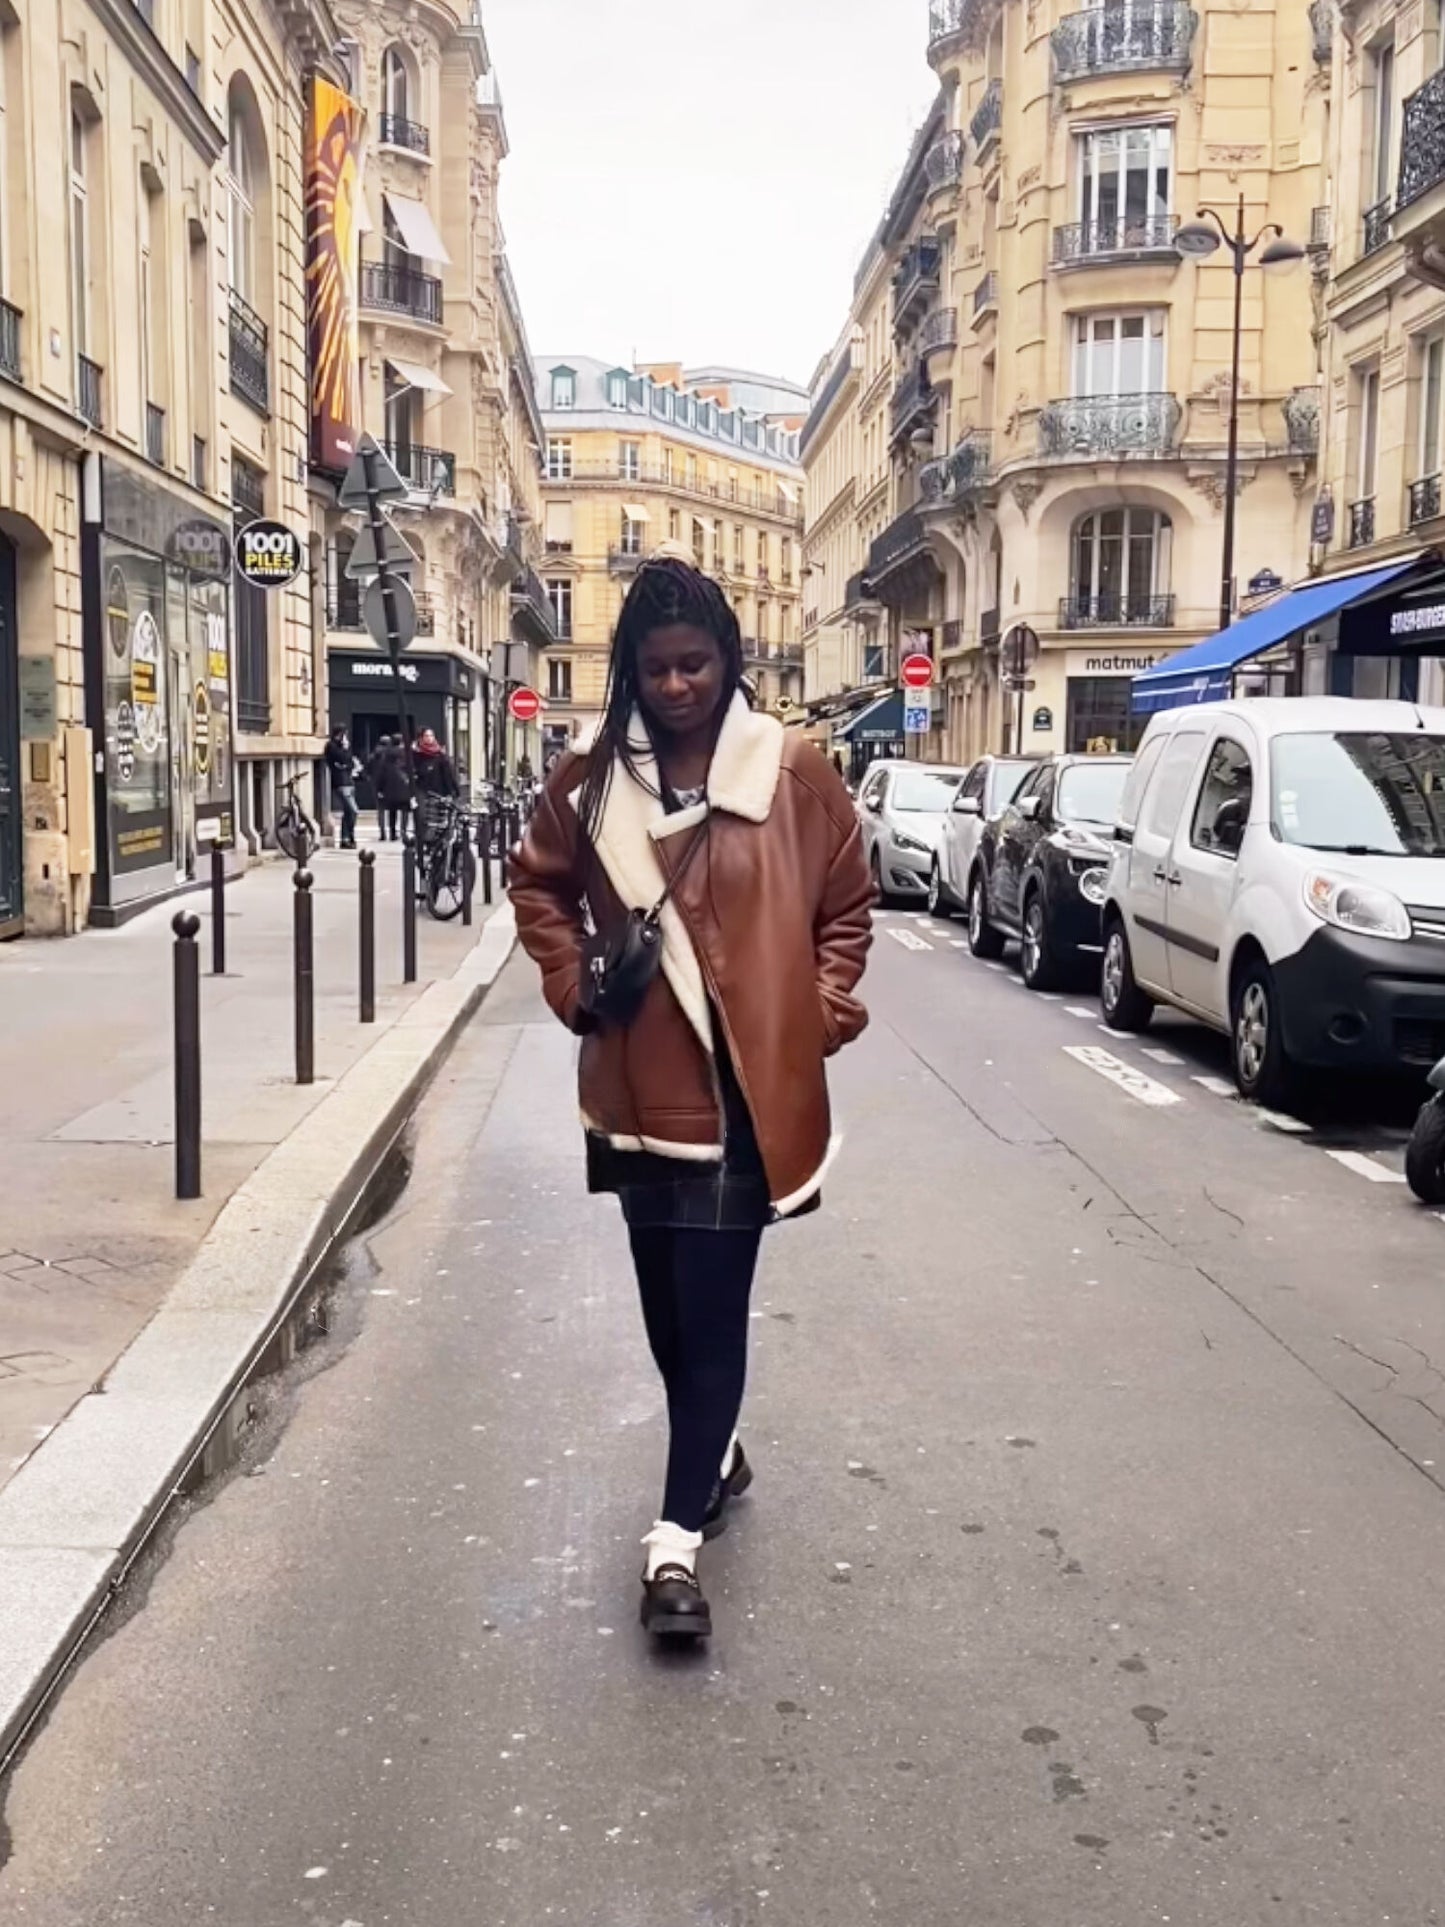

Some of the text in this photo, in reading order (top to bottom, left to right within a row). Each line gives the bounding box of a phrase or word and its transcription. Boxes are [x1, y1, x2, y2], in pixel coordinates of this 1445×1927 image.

[243, 532, 293, 553] 1001
[245, 554, 294, 568] PILES
[1086, 654, 1154, 670] matmut
